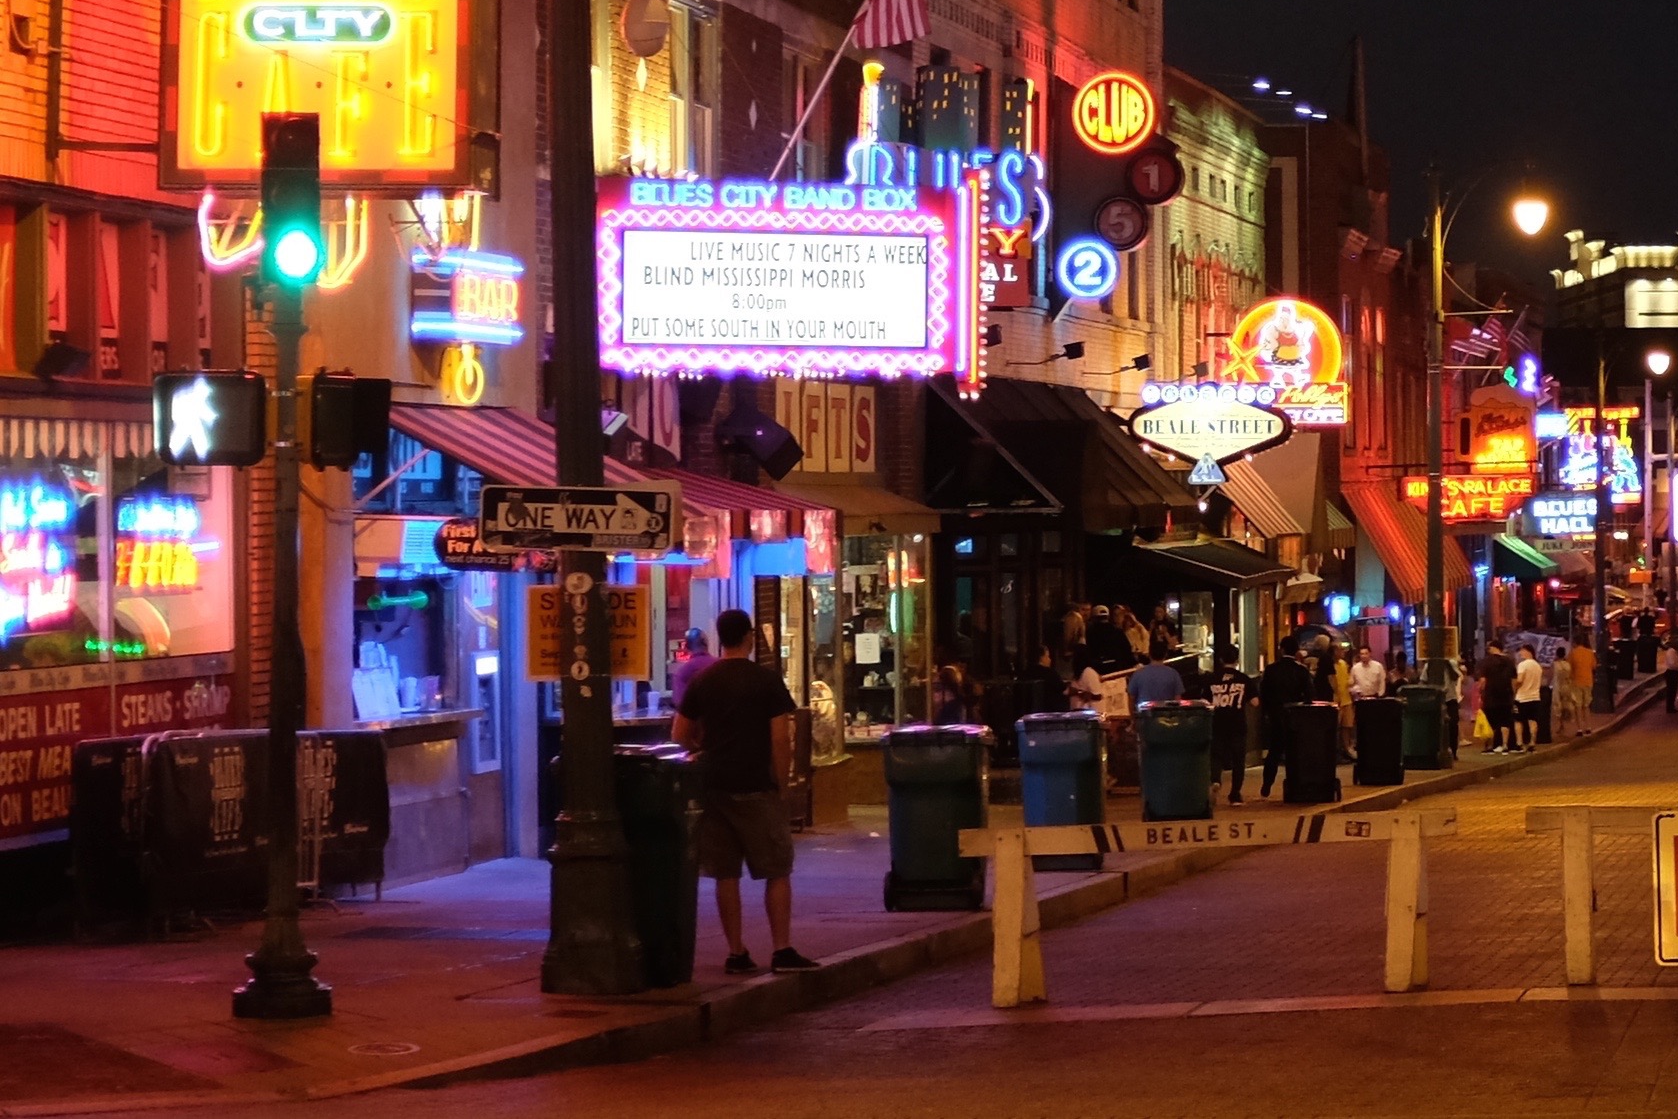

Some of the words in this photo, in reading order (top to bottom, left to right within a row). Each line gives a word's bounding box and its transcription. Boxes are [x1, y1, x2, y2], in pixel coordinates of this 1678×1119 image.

[253, 9, 383, 38] CITY
[194, 11, 437, 158] CAFE
[1082, 84, 1145, 143] CLUB
[1142, 162, 1159, 191] 1
[630, 182, 712, 207] BLUES
[721, 183, 778, 208] CITY
[783, 185, 855, 211] BAND
[864, 187, 918, 212] BOX
[1108, 207, 1134, 237] 5
[691, 241, 724, 262] LIVE
[732, 243, 780, 263] MUSIC
[788, 243, 797, 263] 7
[803, 243, 860, 264] NIGHTS
[867, 245, 877, 264] A
[884, 245, 927, 265] WEEK
[644, 265, 693, 286] BLIND
[701, 266, 794, 288] MISSISSIPPI
[801, 269, 866, 290] MORRIS
[1074, 251, 1102, 284] 2
[457, 276, 518, 322] BAR
[732, 293, 787, 312] 8:00pm
[631, 317, 661, 338] PUT
[665, 318, 706, 339] SOME
[711, 318, 760, 339] SOUTH
[766, 319, 781, 339] IN
[787, 319, 827, 340] YOUR
[833, 320, 886, 340] MOUTH
[781, 390, 874, 463] IFTS
[1143, 420, 1200, 434] BEALE
[1208, 420, 1276, 434] STREET
[1407, 479, 1464, 497] KIN'S
[1463, 479, 1532, 495] PALACE
[505, 507, 553, 529] ONE
[565, 507, 616, 530] WAY
[1441, 497, 1503, 518] CAFE
[1533, 499, 1597, 517] BLUES
[1541, 518, 1594, 534] HALL
[447, 541, 467, 553] For
[1571, 542, 1596, 550] JOIN
[0, 706, 37, 739] OPEN
[45, 702, 82, 732] LATE
[121, 691, 173, 728] STEAKS
[0, 749, 33, 786] BEST
[37, 744, 72, 780] MEA
[0, 792, 22, 827] ON
[31, 786, 71, 822] BEAL
[1146, 824, 1219, 845] BEALE
[1228, 821, 1268, 841] ST.
